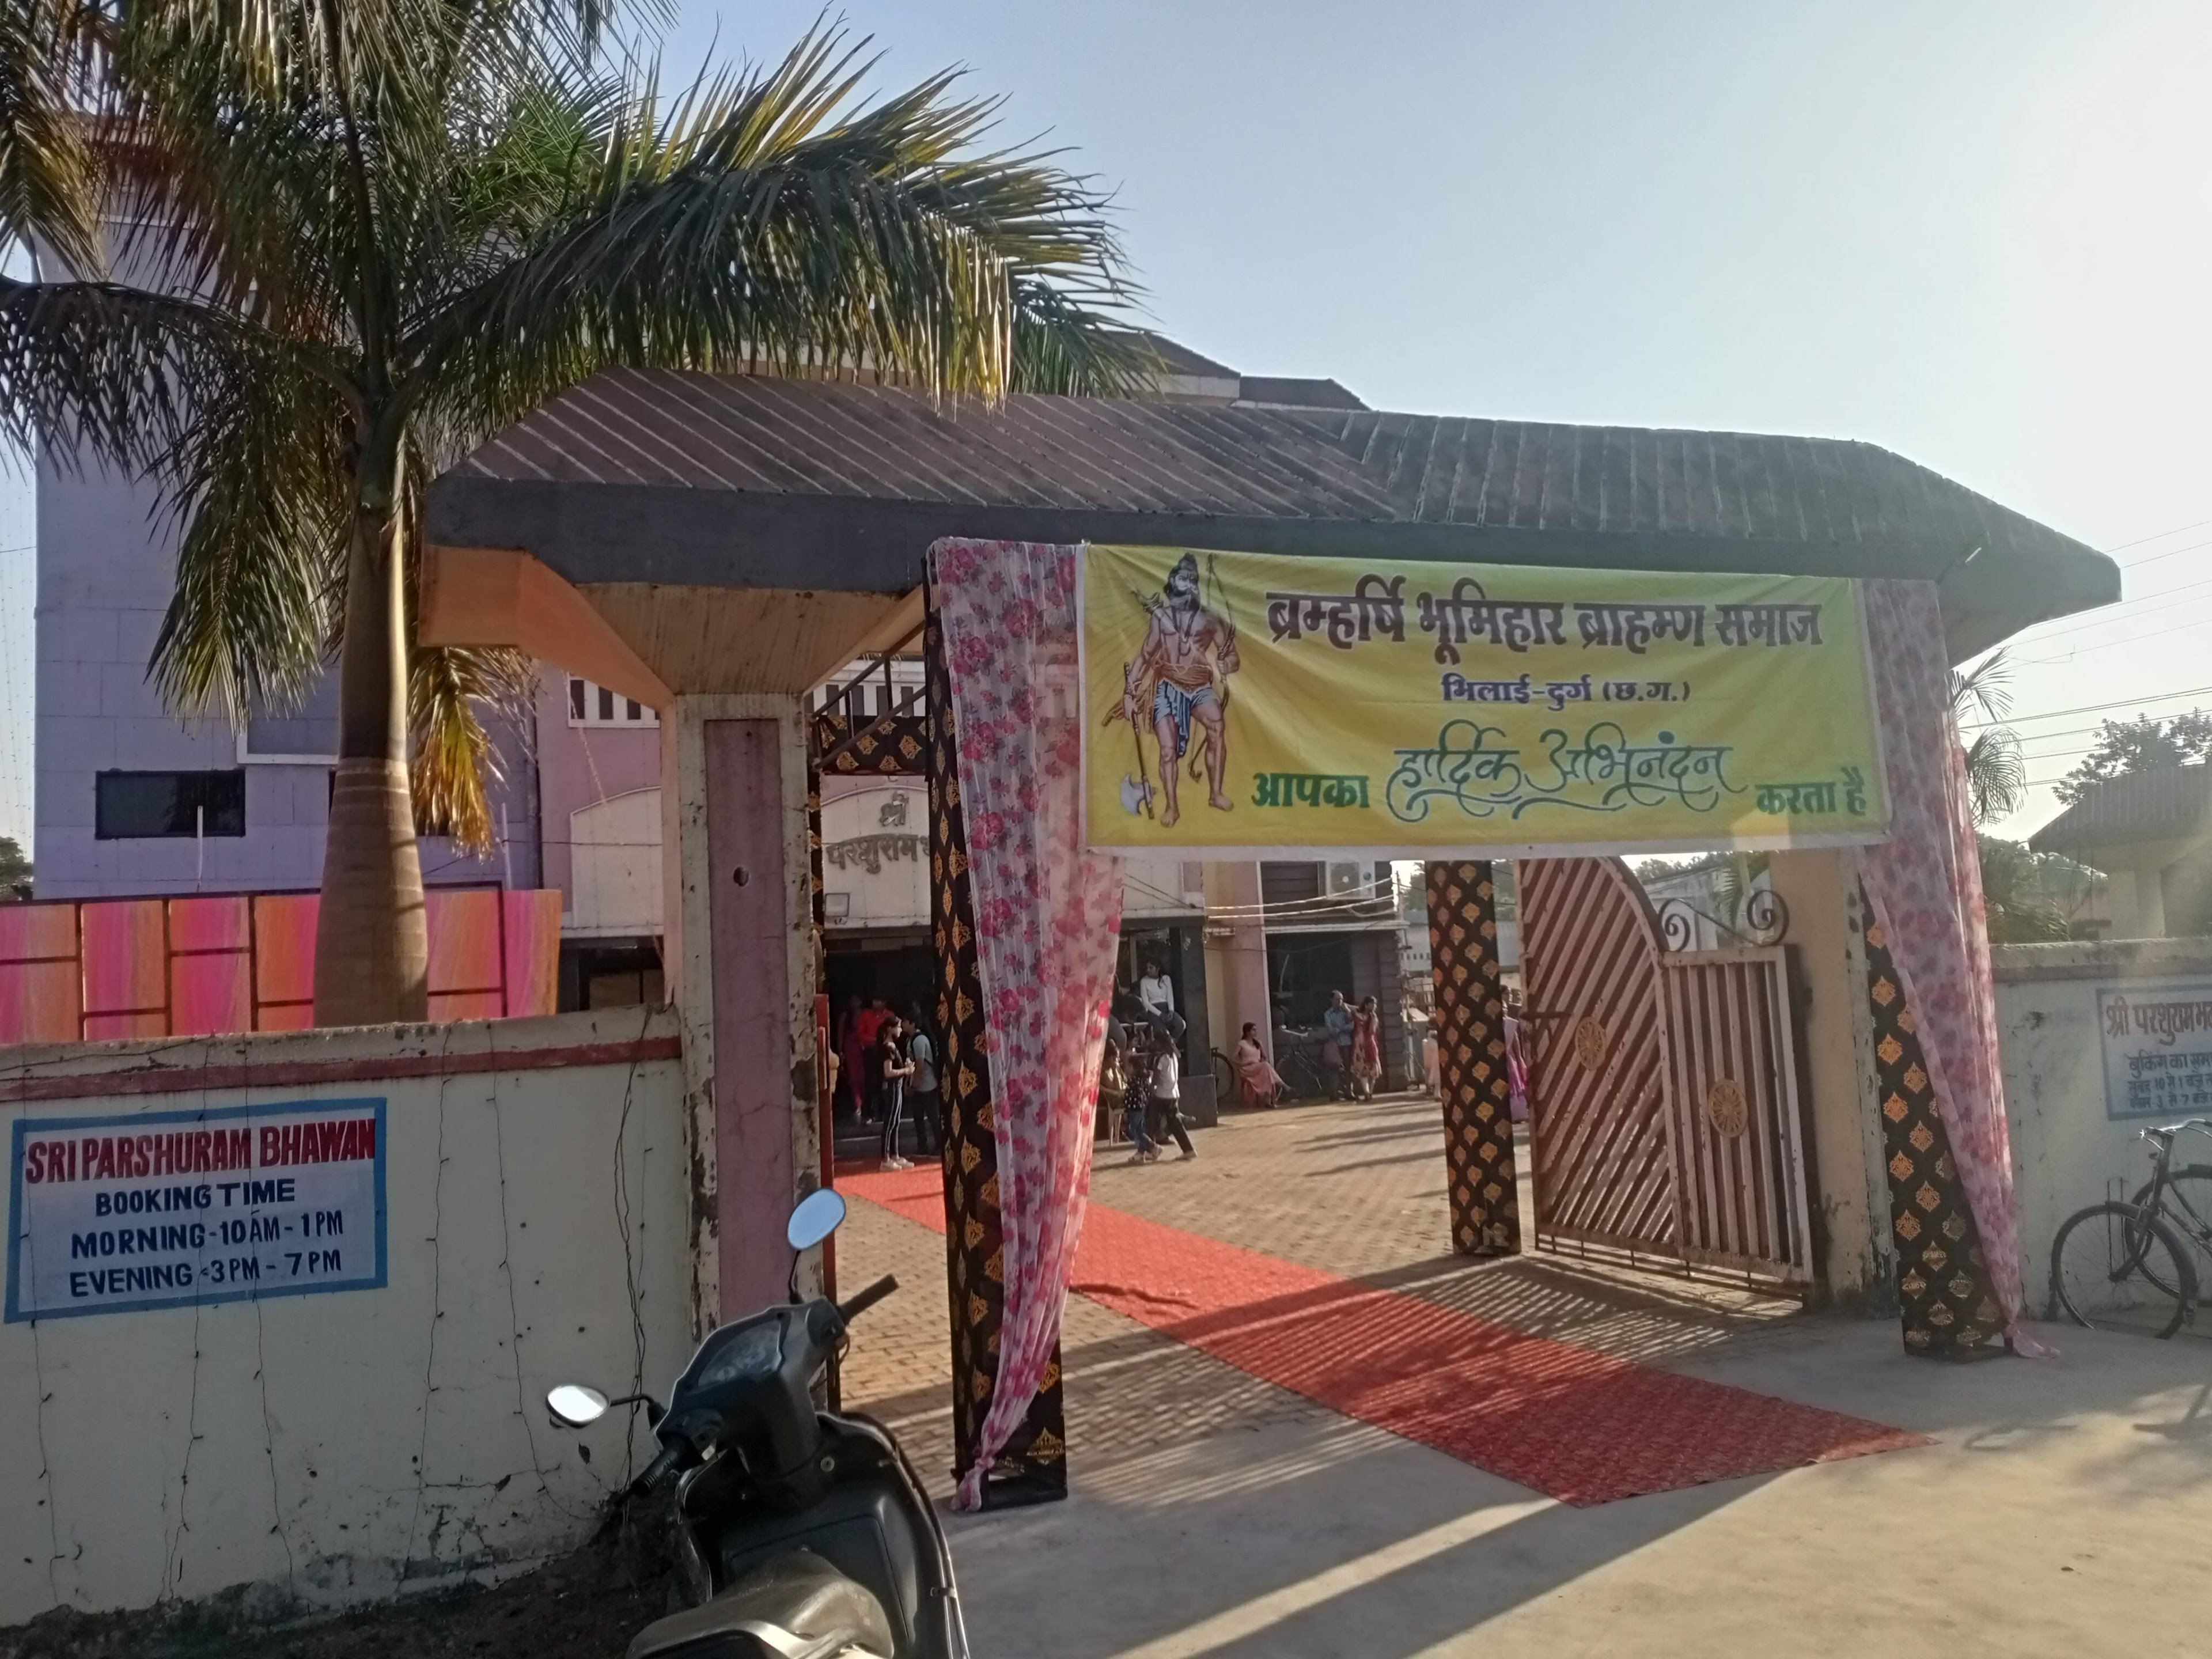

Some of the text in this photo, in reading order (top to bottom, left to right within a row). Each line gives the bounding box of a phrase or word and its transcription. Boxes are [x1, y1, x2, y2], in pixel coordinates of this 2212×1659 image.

[1416, 576, 1566, 665] भूमिहार
[1715, 603, 1823, 647] समाज
[1251, 772, 1370, 809] आपका
[1524, 721, 1749, 812] अभिनंदन
[1754, 782, 1836, 815] करता
[1840, 766, 1866, 816] है
[825, 833, 919, 874] परशुराम
[2106, 995, 2130, 1039] श्री
[2168, 1054, 2188, 1069] का
[25, 1118, 376, 1184] SRI PARSHURAM BHAWAN
[95, 1178, 296, 1217] BOOKING TIME
